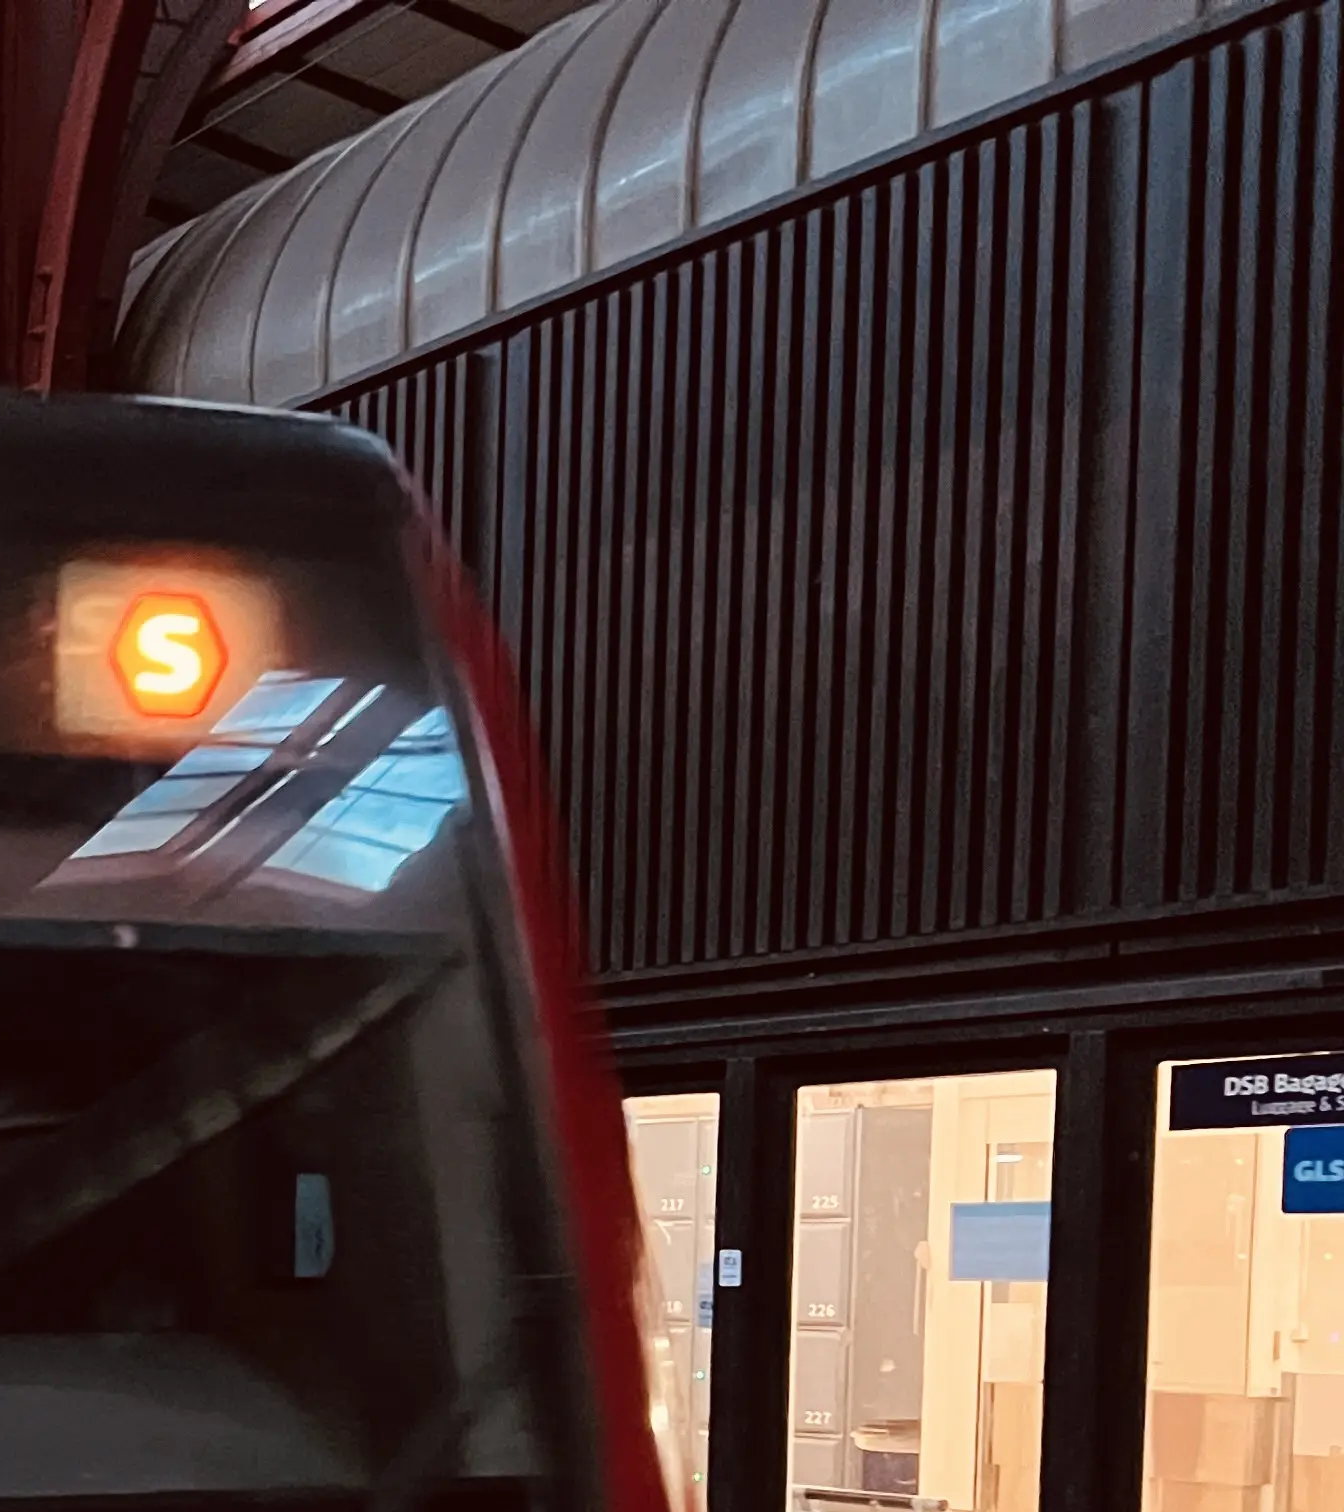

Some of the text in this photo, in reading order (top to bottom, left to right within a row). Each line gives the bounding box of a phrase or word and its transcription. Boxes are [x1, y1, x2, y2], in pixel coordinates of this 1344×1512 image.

[134, 613, 202, 694] S
[1224, 1075, 1269, 1096] DSB
[1293, 1159, 1344, 1182] GLS
[660, 1198, 684, 1212] 217
[811, 1195, 839, 1209] 225
[807, 1304, 836, 1318] 226
[804, 1411, 832, 1425] 227
